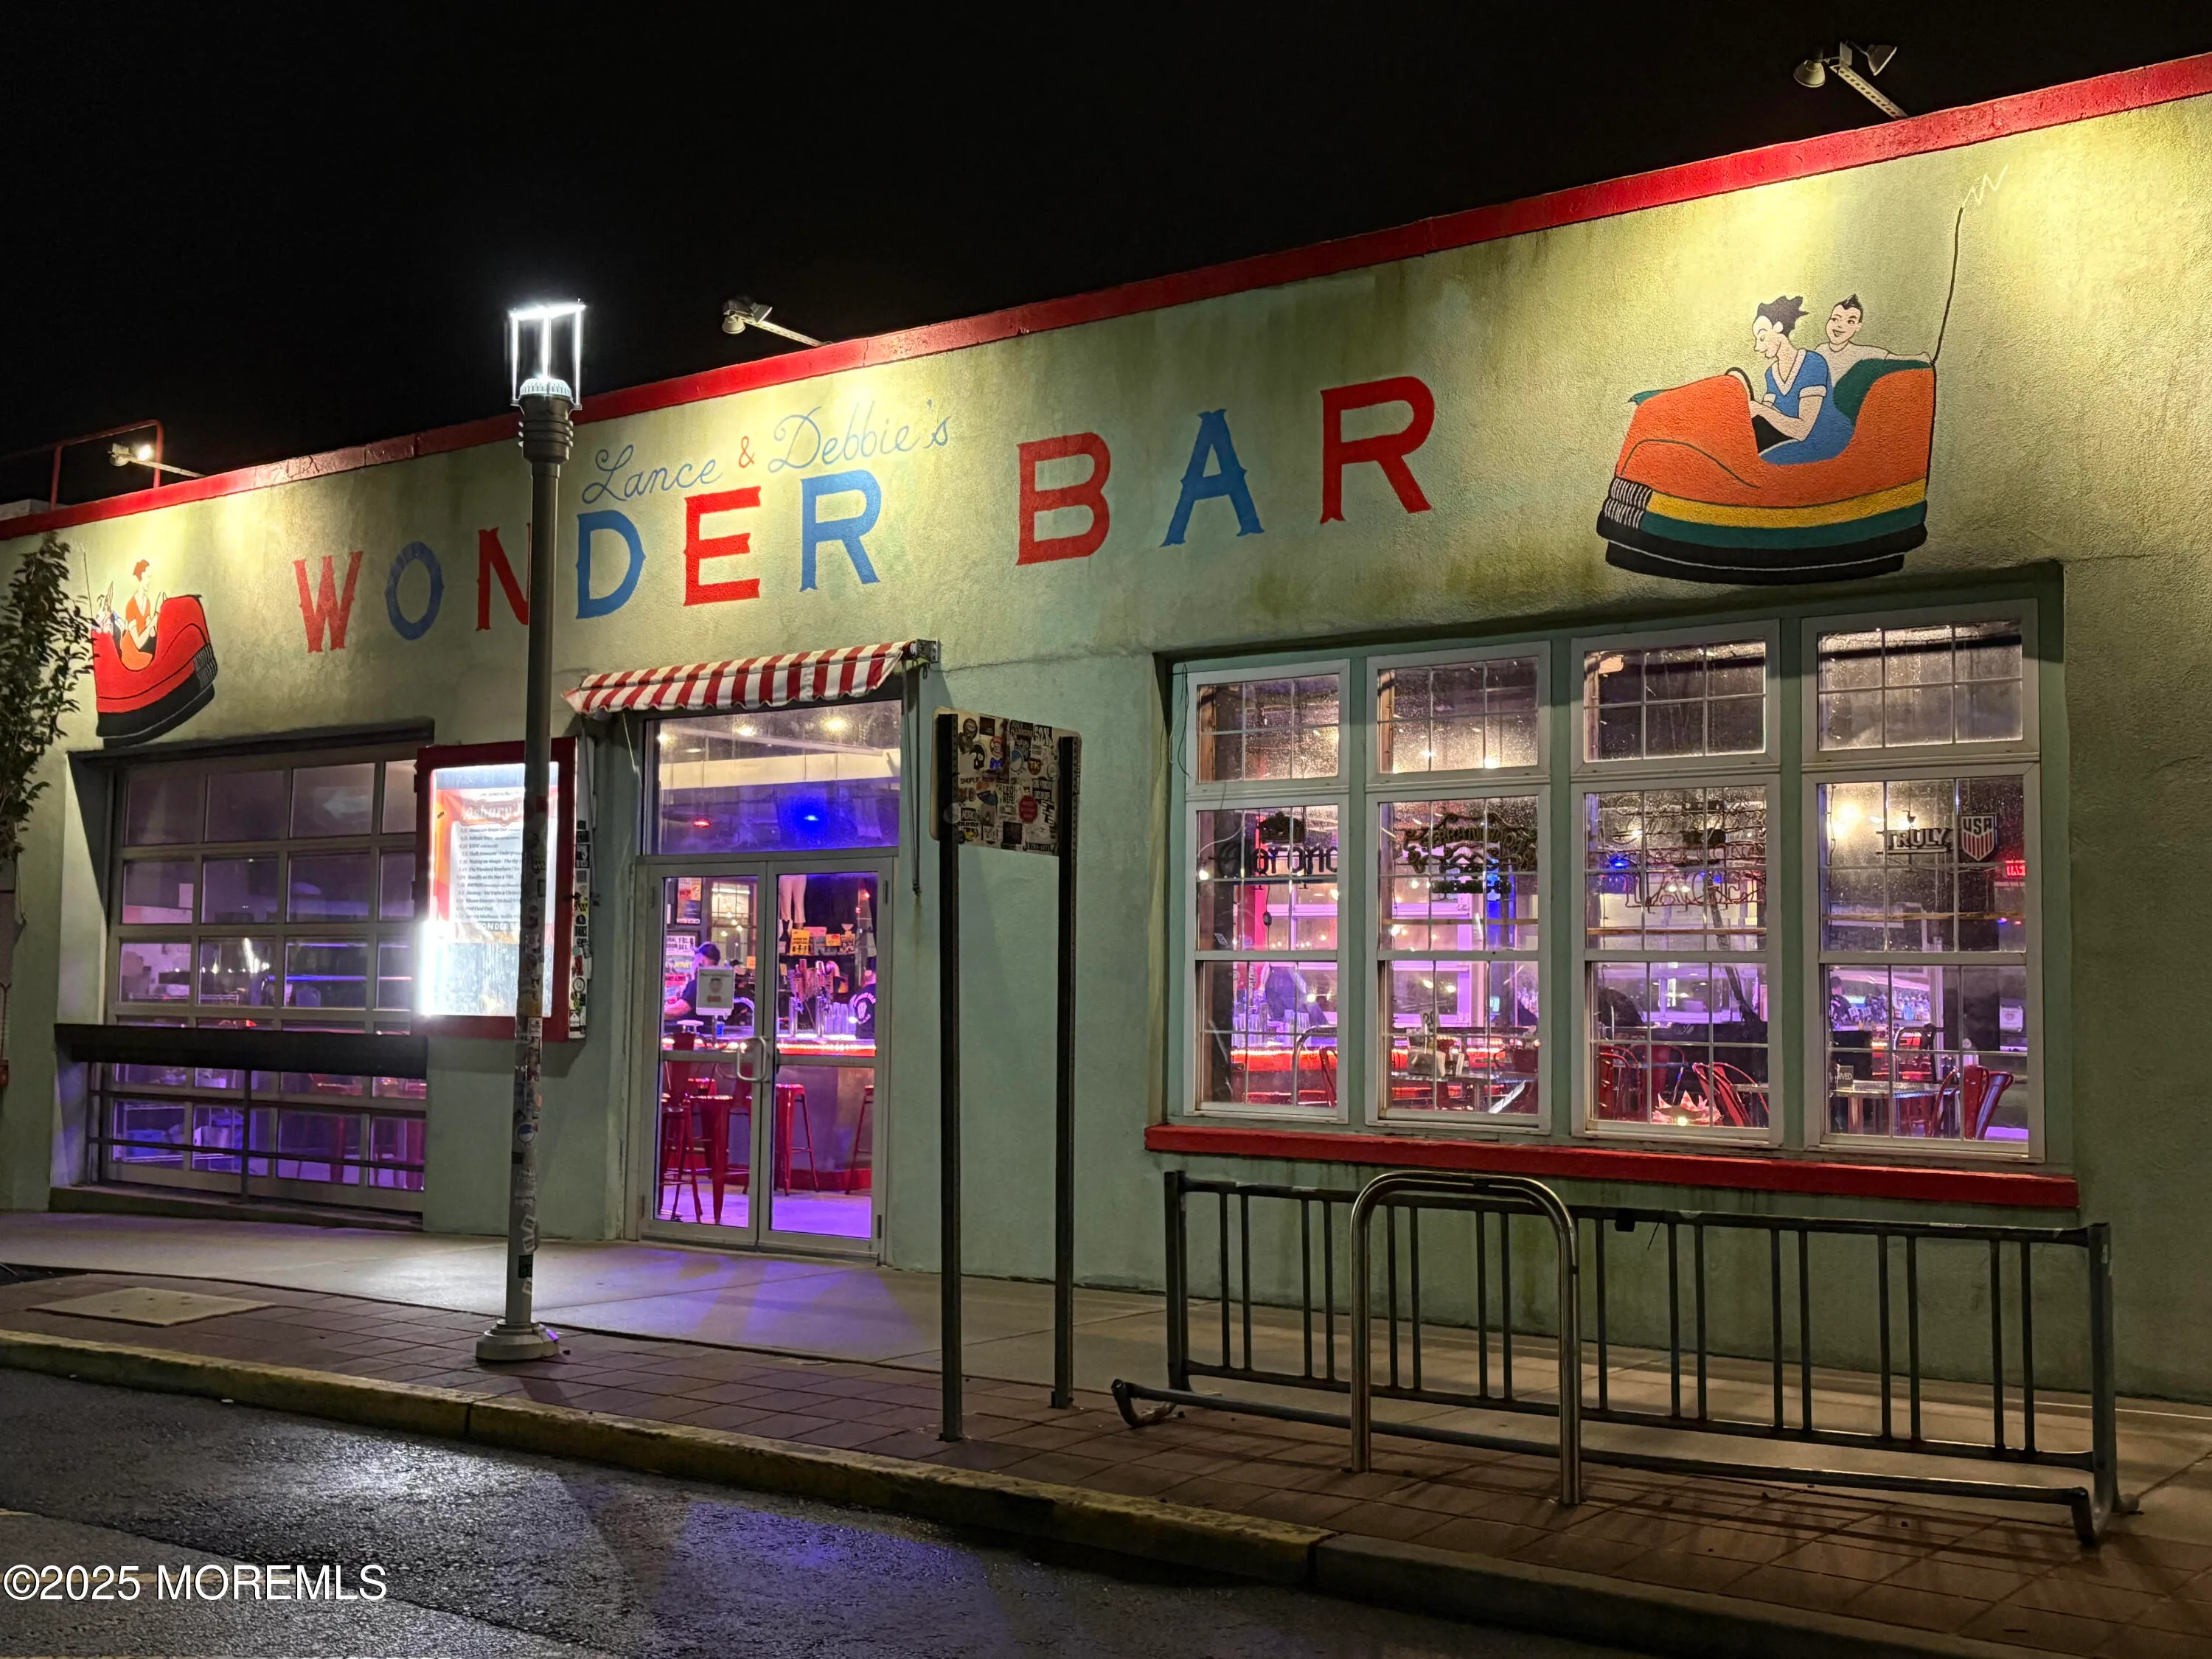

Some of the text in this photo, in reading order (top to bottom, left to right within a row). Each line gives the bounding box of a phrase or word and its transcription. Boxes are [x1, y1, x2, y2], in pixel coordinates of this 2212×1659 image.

[582, 398, 952, 504] Lance & Debbie's
[293, 375, 1435, 653] WONDER BAR
[1887, 827, 1947, 848] TRULY
[1963, 817, 1992, 835] USA
